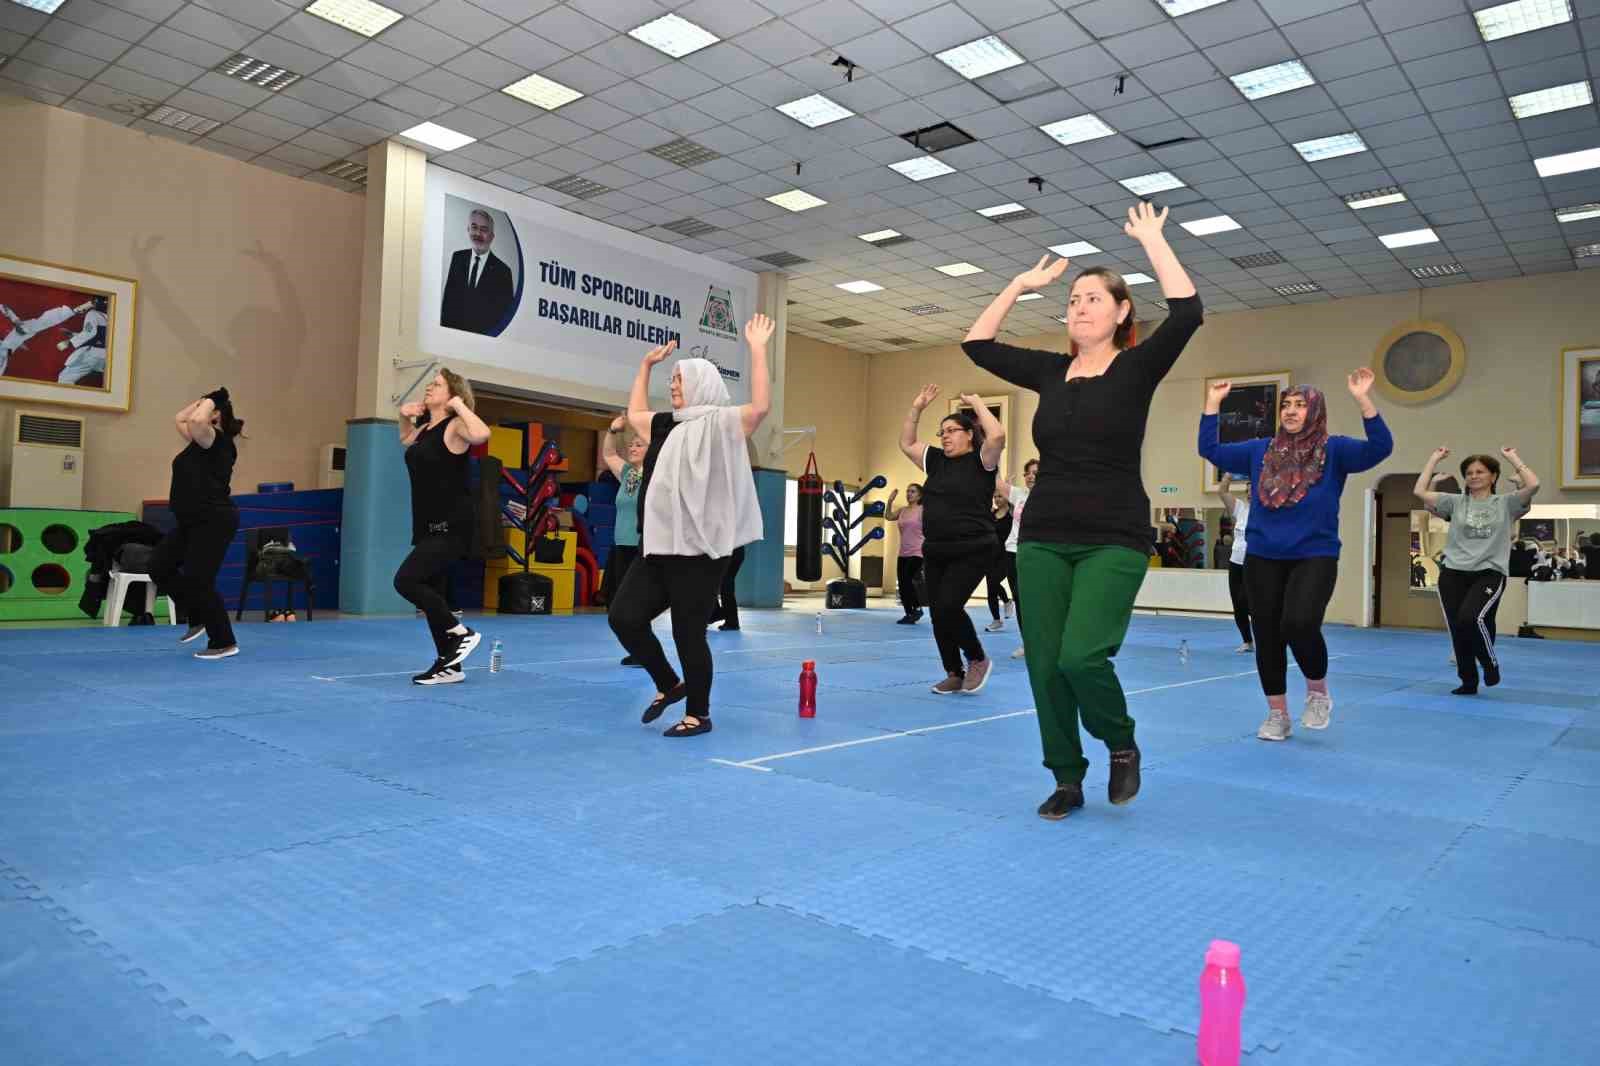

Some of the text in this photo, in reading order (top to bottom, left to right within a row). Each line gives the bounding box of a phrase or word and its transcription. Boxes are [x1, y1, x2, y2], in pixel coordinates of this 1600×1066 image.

[539, 260, 681, 319] TÜM SPORCULARA
[538, 298, 622, 336] BAŞARILAR
[626, 319, 681, 350] DİLERİM
